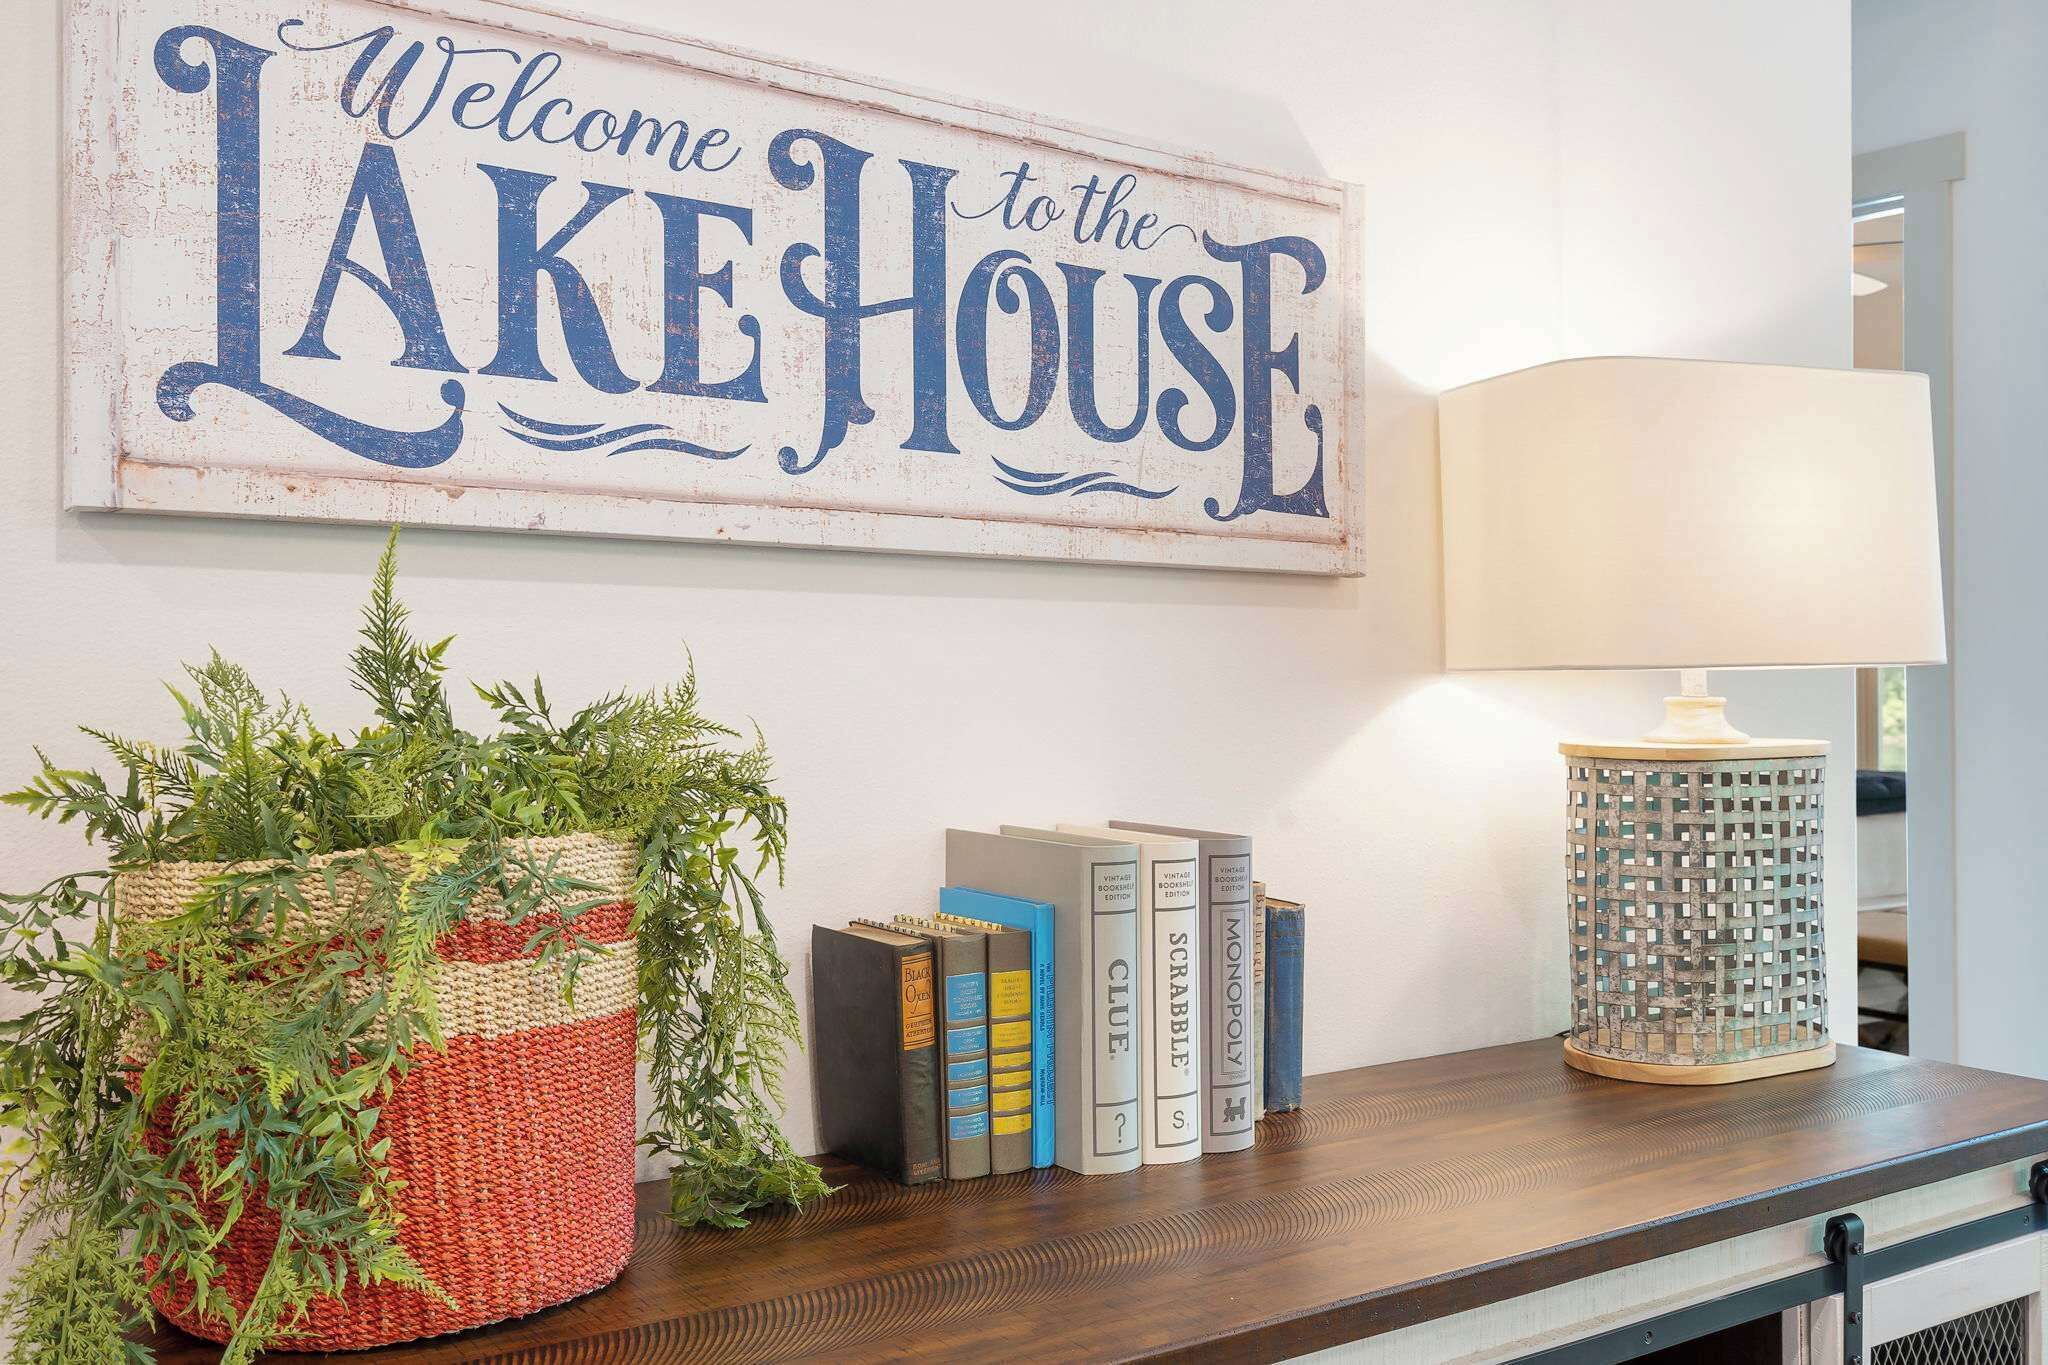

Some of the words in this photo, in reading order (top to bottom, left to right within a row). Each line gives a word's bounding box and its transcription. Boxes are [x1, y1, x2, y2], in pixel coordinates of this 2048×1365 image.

[277, 19, 742, 172] Welcome
[951, 162, 1065, 232] to
[1071, 174, 1198, 251] the
[153, 25, 768, 468] LAKE
[768, 128, 1330, 521] HOUSE
[1220, 866, 1246, 874] VINTAGE
[1103, 873, 1132, 882] VINTAGE
[1163, 872, 1191, 880] VINTAGE
[1214, 874, 1248, 884] BOOKSHELF
[1098, 883, 1135, 892] BOOKSHELF
[1158, 880, 1194, 889] BOOKSHELF
[1220, 884, 1245, 892] EDITION
[1105, 893, 1131, 901] EDITION
[1165, 890, 1190, 898] EDITION
[904, 967, 931, 982] BLACK
[1226, 918, 1243, 1066] MONOPOLY
[1169, 932, 1190, 1068] SCRABBLE
[1108, 959, 1129, 1054] CLUE
